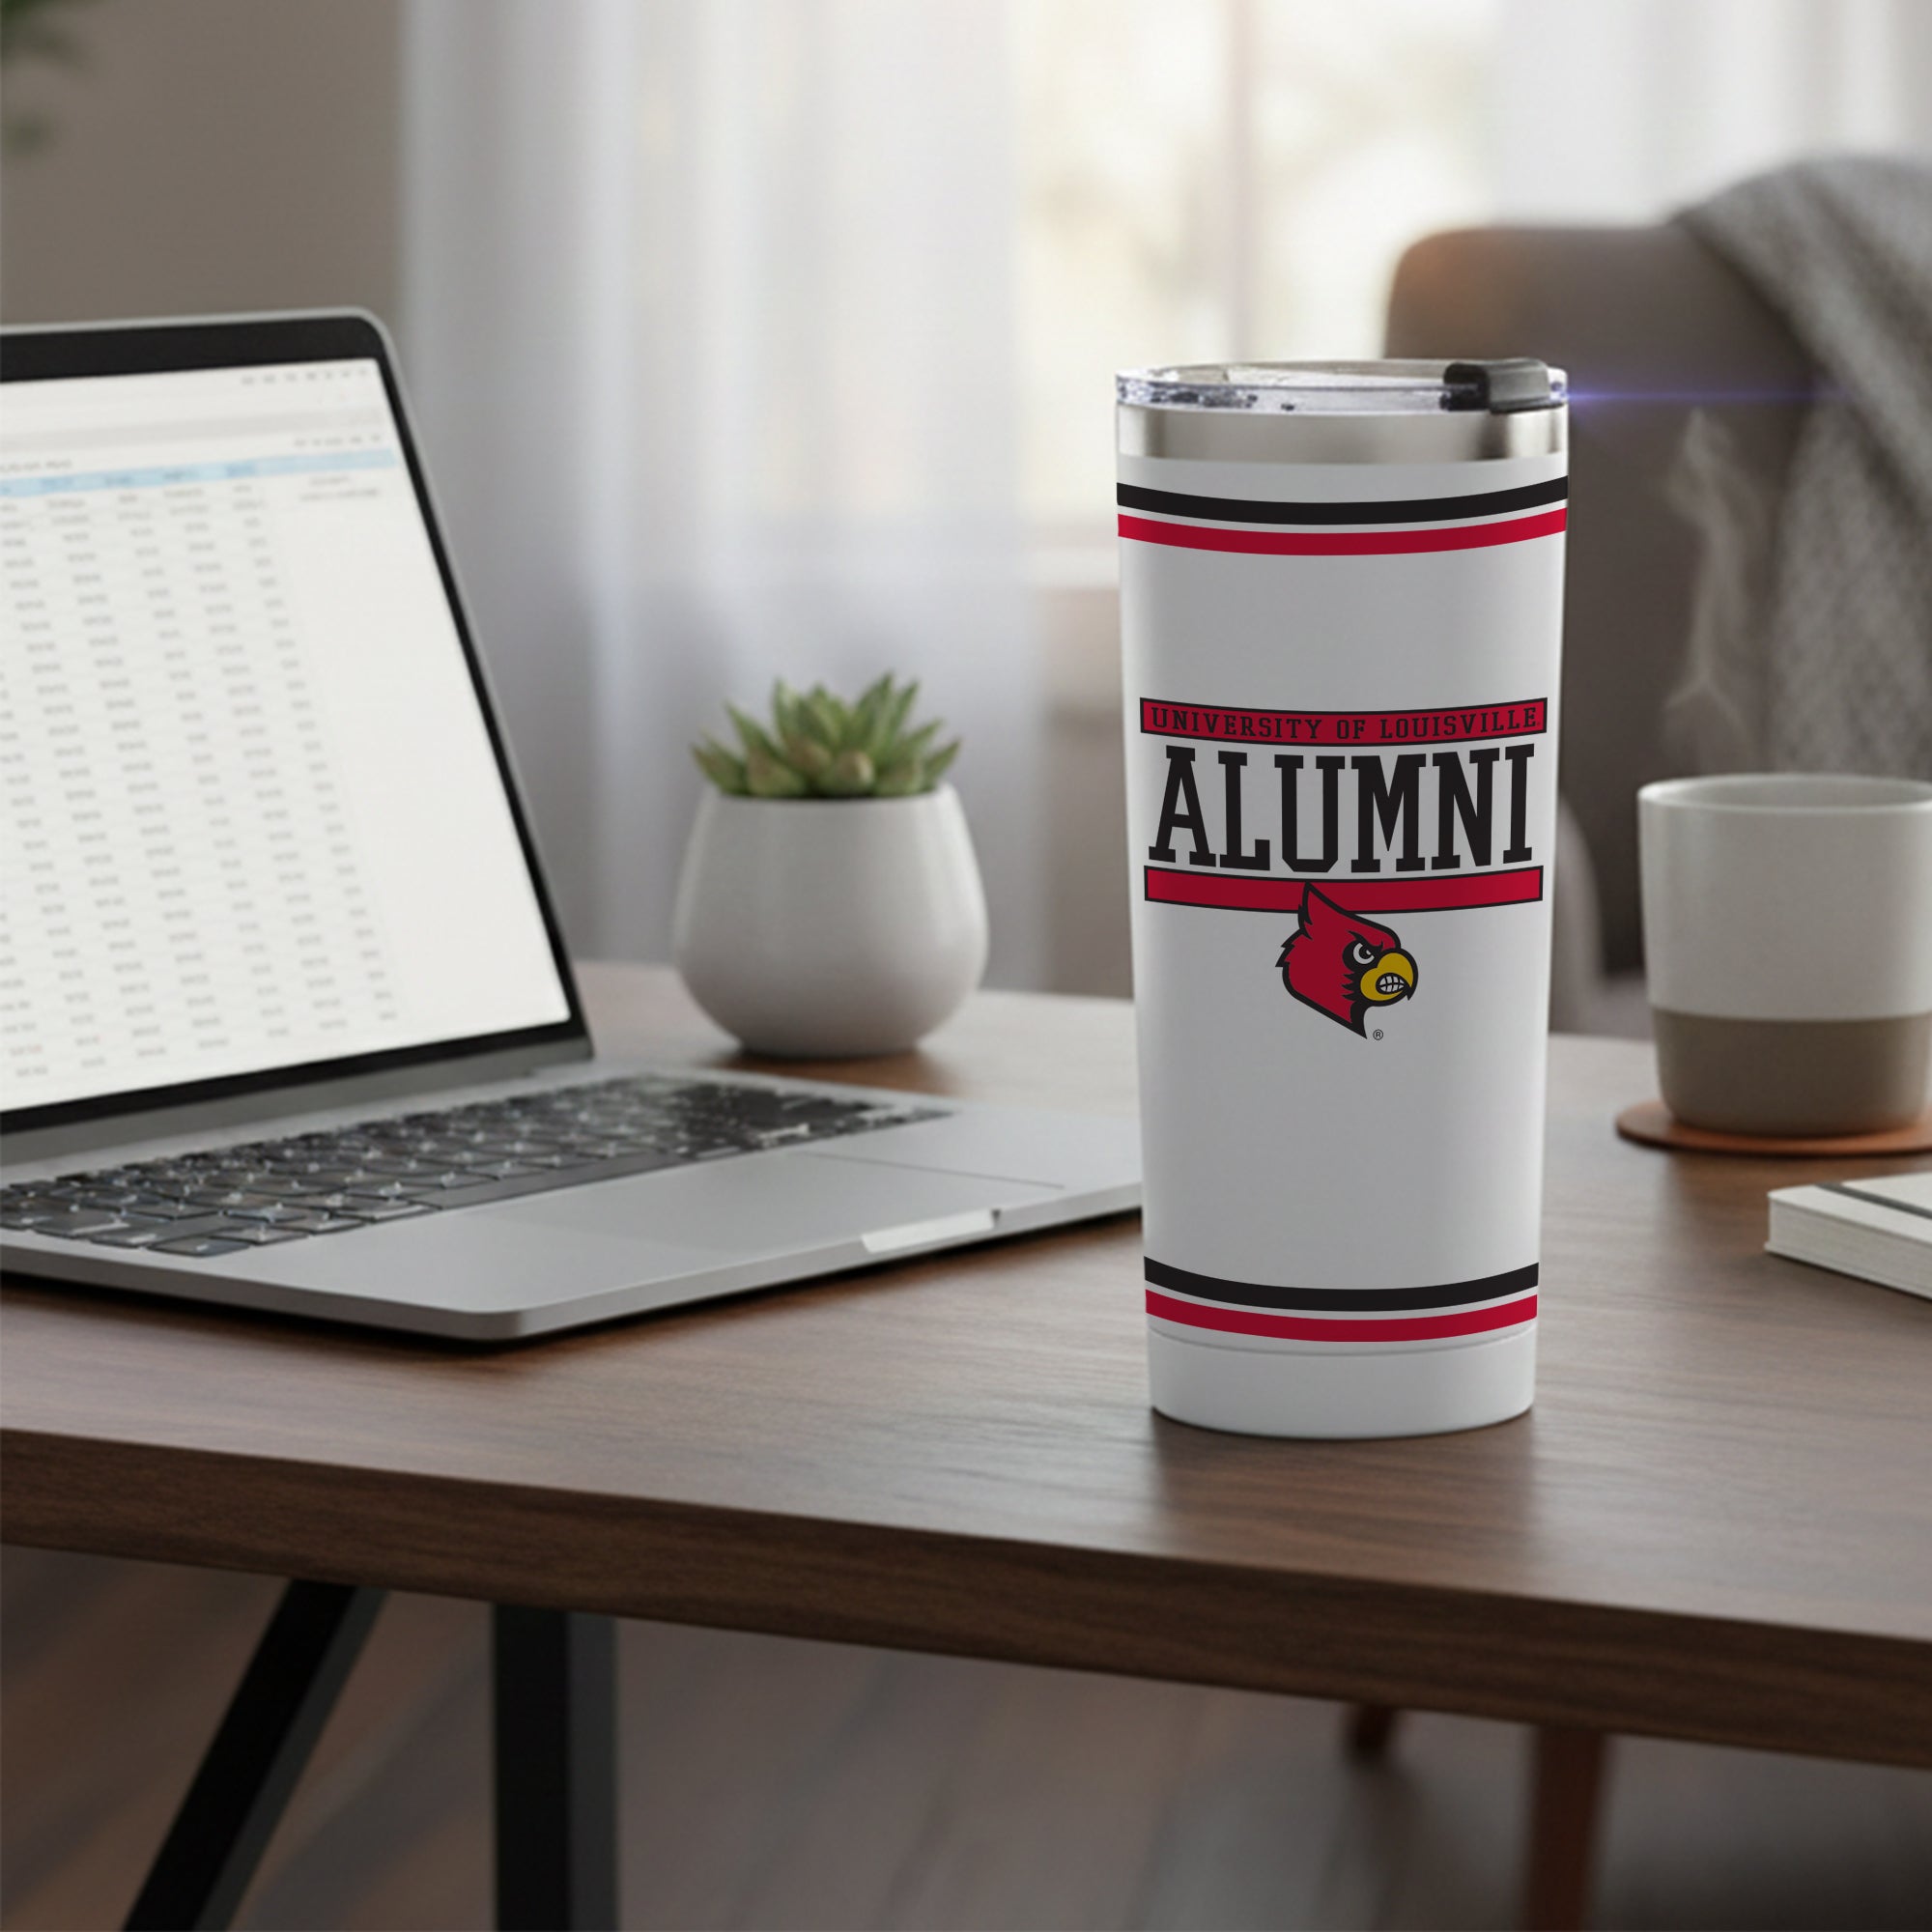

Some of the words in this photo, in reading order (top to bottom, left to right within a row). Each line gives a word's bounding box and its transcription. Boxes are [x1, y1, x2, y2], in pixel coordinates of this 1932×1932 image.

[1151, 707, 1322, 739] UNIVERSITY
[1337, 719, 1366, 739] OF
[1380, 707, 1537, 739] LOUISVILLE
[1149, 743, 1535, 873] ALUMNI
